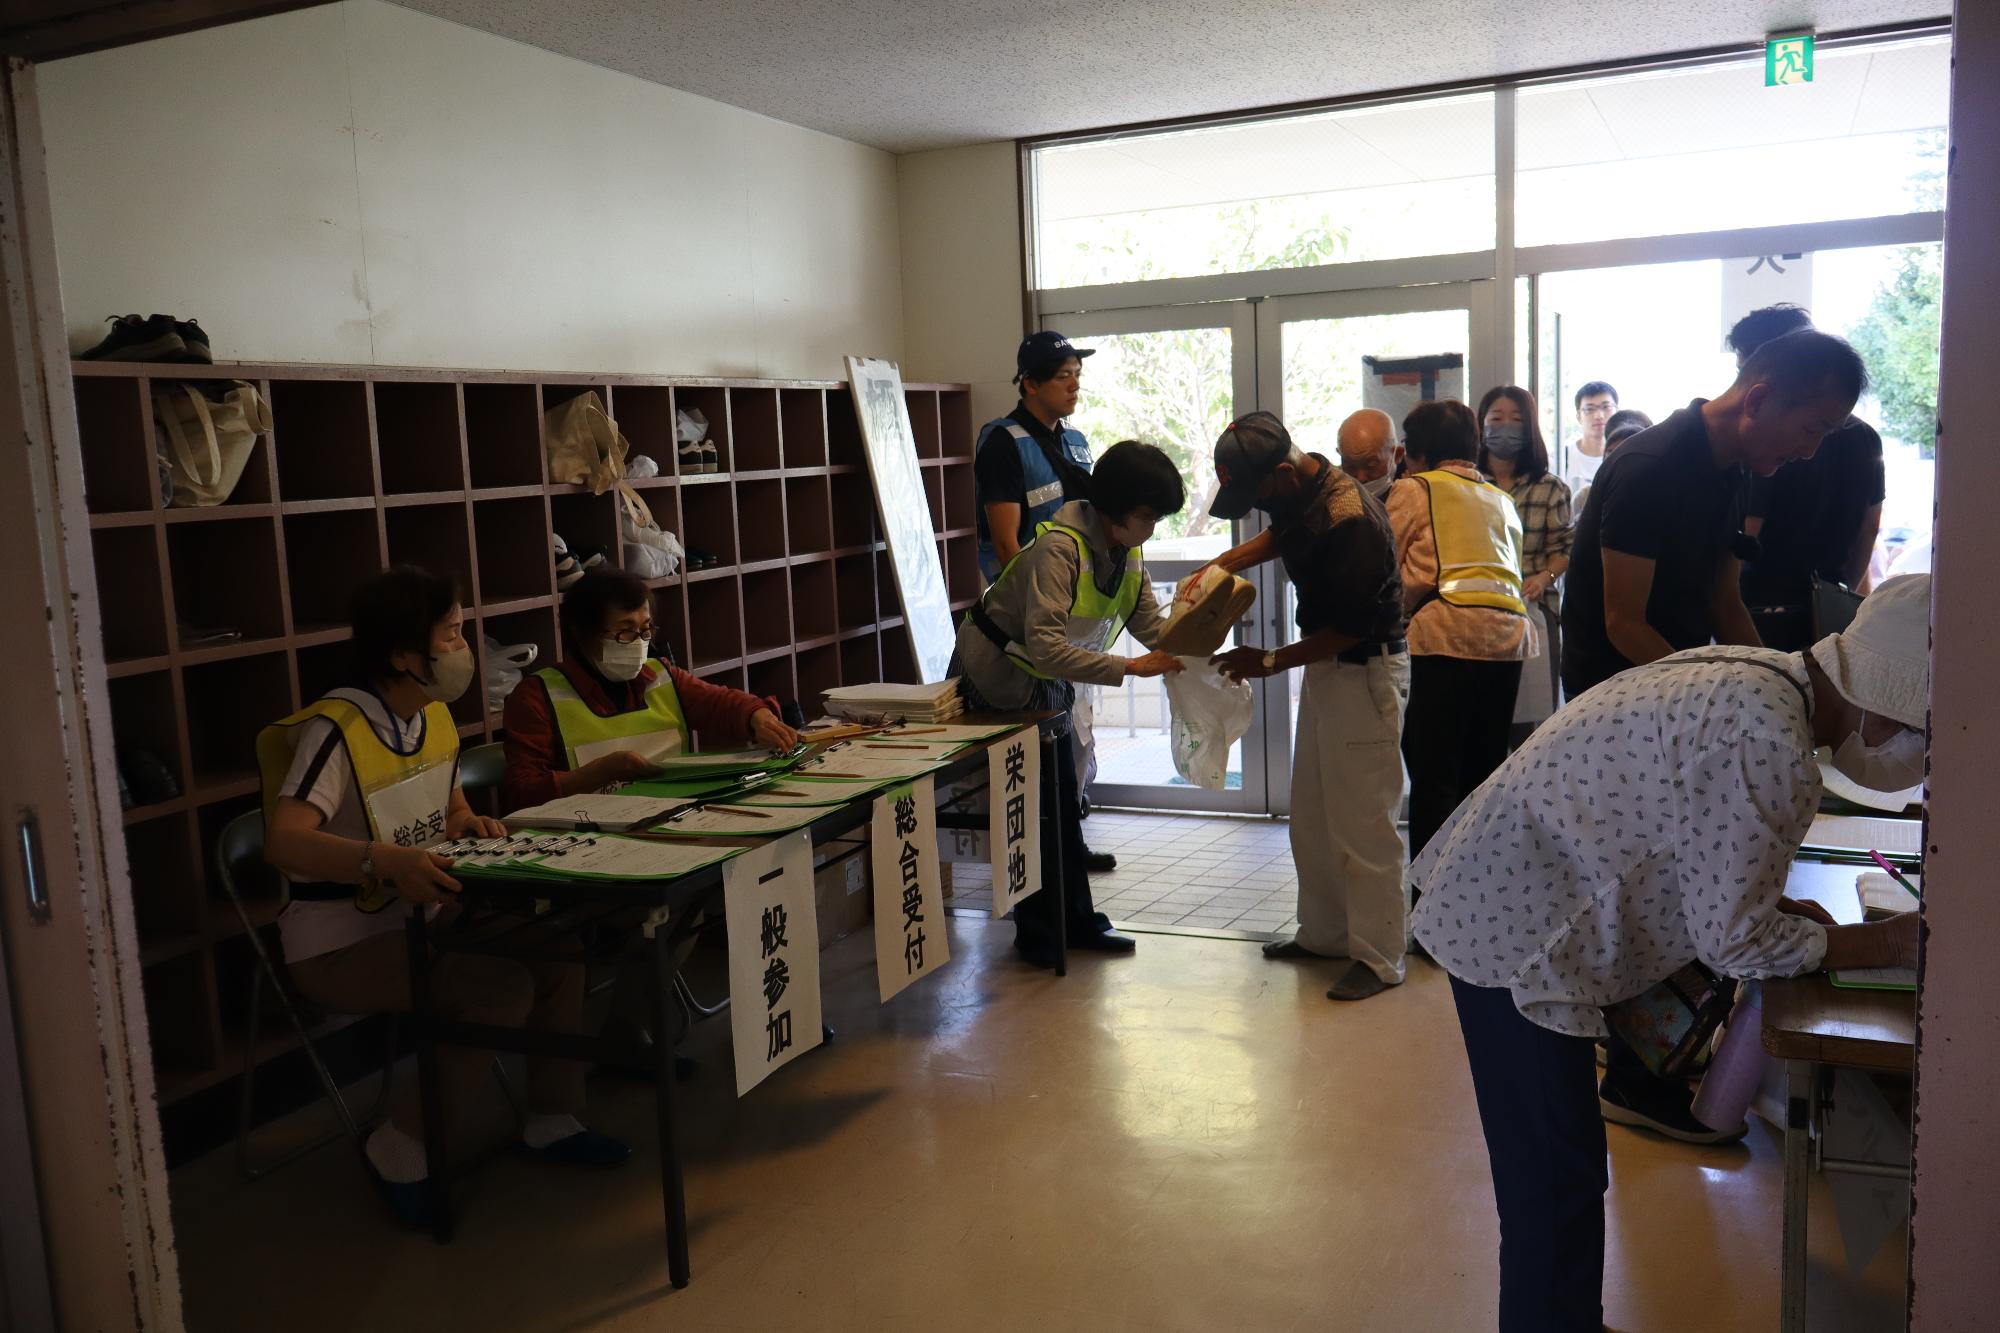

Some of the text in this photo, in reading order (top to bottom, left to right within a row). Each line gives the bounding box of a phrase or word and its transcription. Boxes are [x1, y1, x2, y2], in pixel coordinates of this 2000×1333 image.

[393, 806, 447, 847] 総合受
[894, 794, 927, 975] 総合受付
[1004, 741, 1027, 896] 栄団地
[758, 866, 793, 1063] 一般参加
